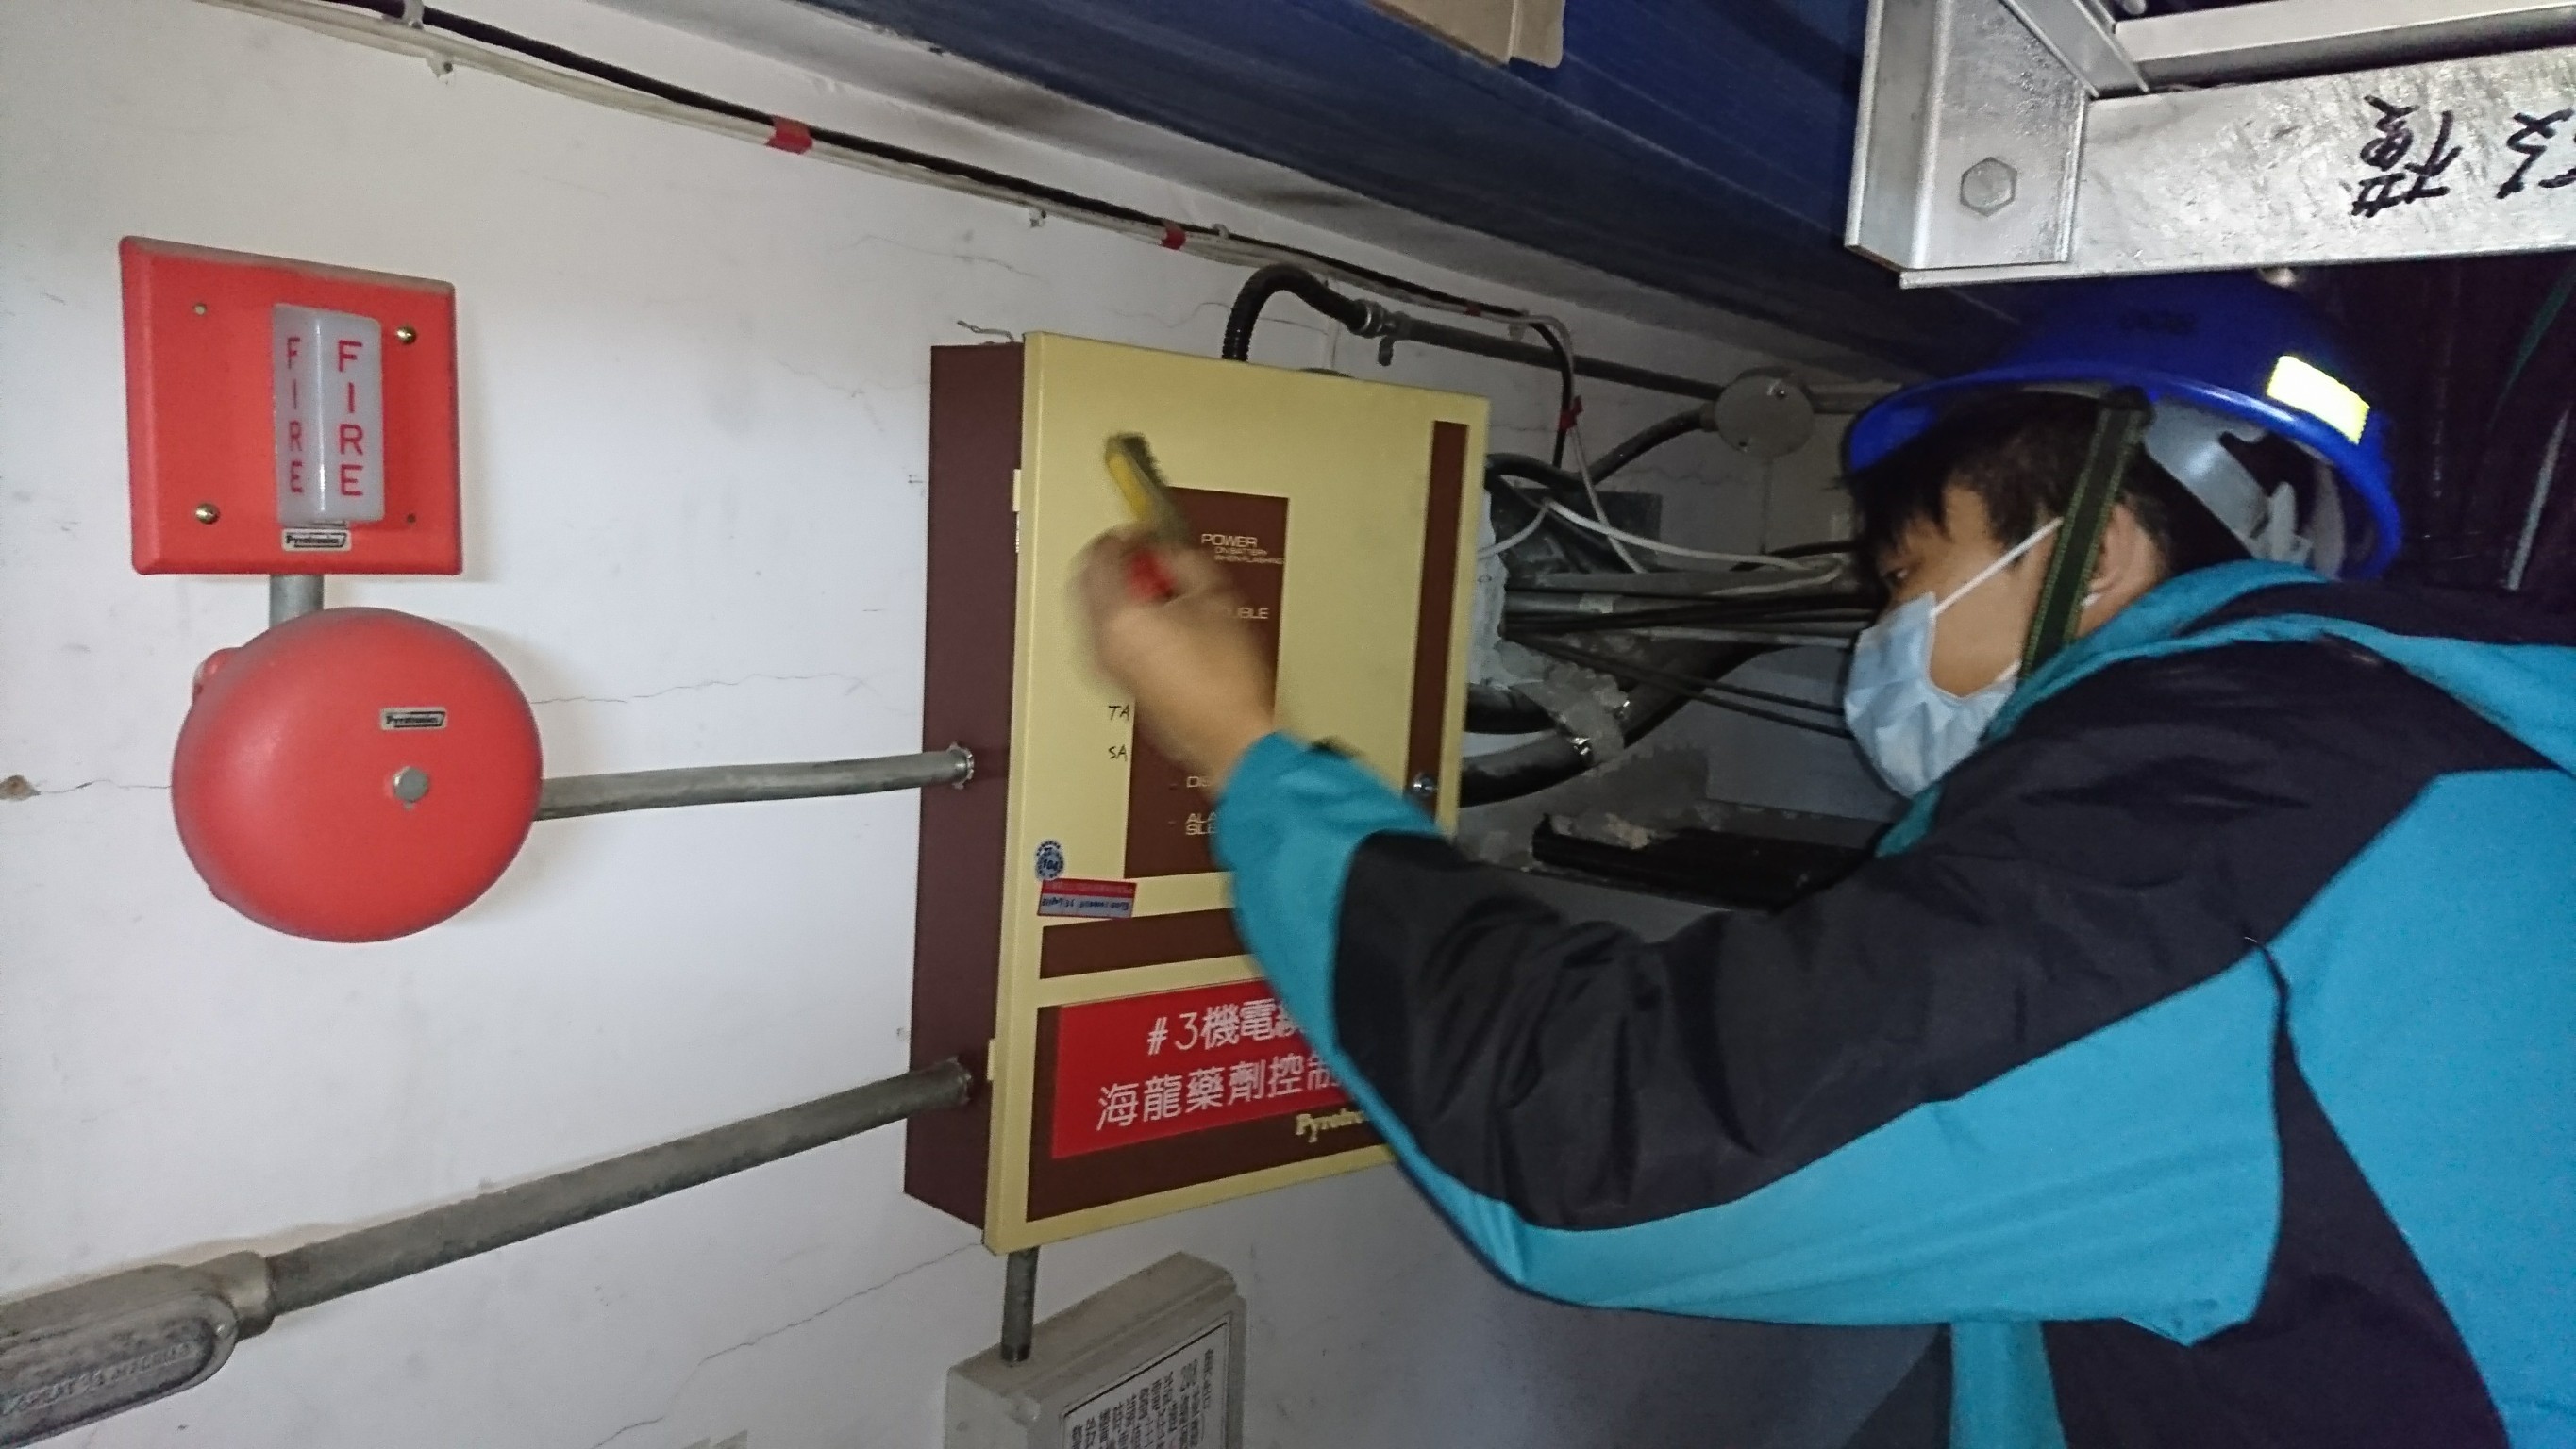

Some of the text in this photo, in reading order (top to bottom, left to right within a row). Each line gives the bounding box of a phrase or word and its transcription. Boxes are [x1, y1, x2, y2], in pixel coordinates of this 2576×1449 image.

[287, 336, 304, 494] FIRE
[337, 340, 364, 497] FIRE
[1201, 533, 1258, 548] POWER
[1108, 704, 1129, 721] TA
[1108, 744, 1128, 762] SA
